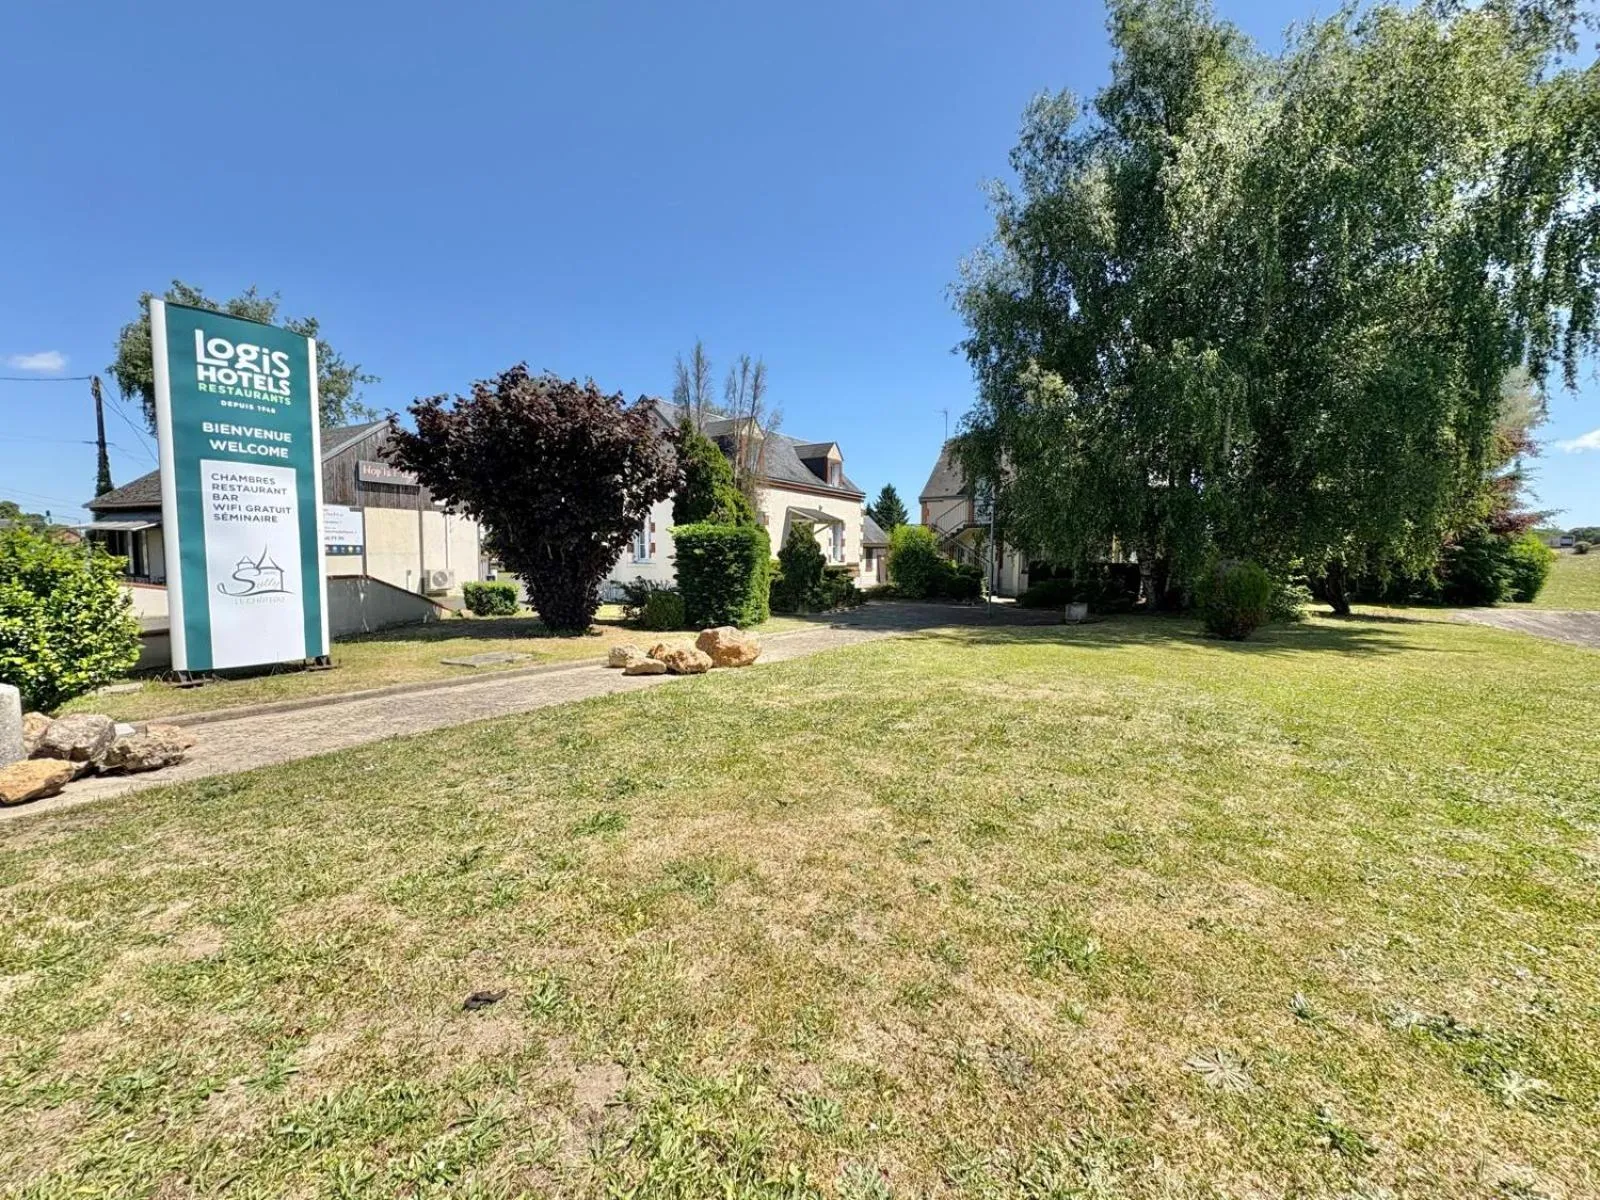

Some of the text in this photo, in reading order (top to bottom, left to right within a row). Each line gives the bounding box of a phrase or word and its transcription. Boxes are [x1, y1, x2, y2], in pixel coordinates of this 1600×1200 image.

[197, 364, 291, 396] HOTELS
[197, 382, 292, 406] RESTAURANTS
[220, 399, 254, 411] DEPUIS
[202, 421, 293, 443] BIENVENUE
[209, 439, 289, 459] WELCOME
[211, 472, 277, 486] CHAMBRES
[211, 483, 287, 496] RESTAURANT
[212, 493, 239, 502] BAR
[213, 503, 292, 514] WIFI GRATUIT
[213, 511, 279, 523] SÉMINAIRE
